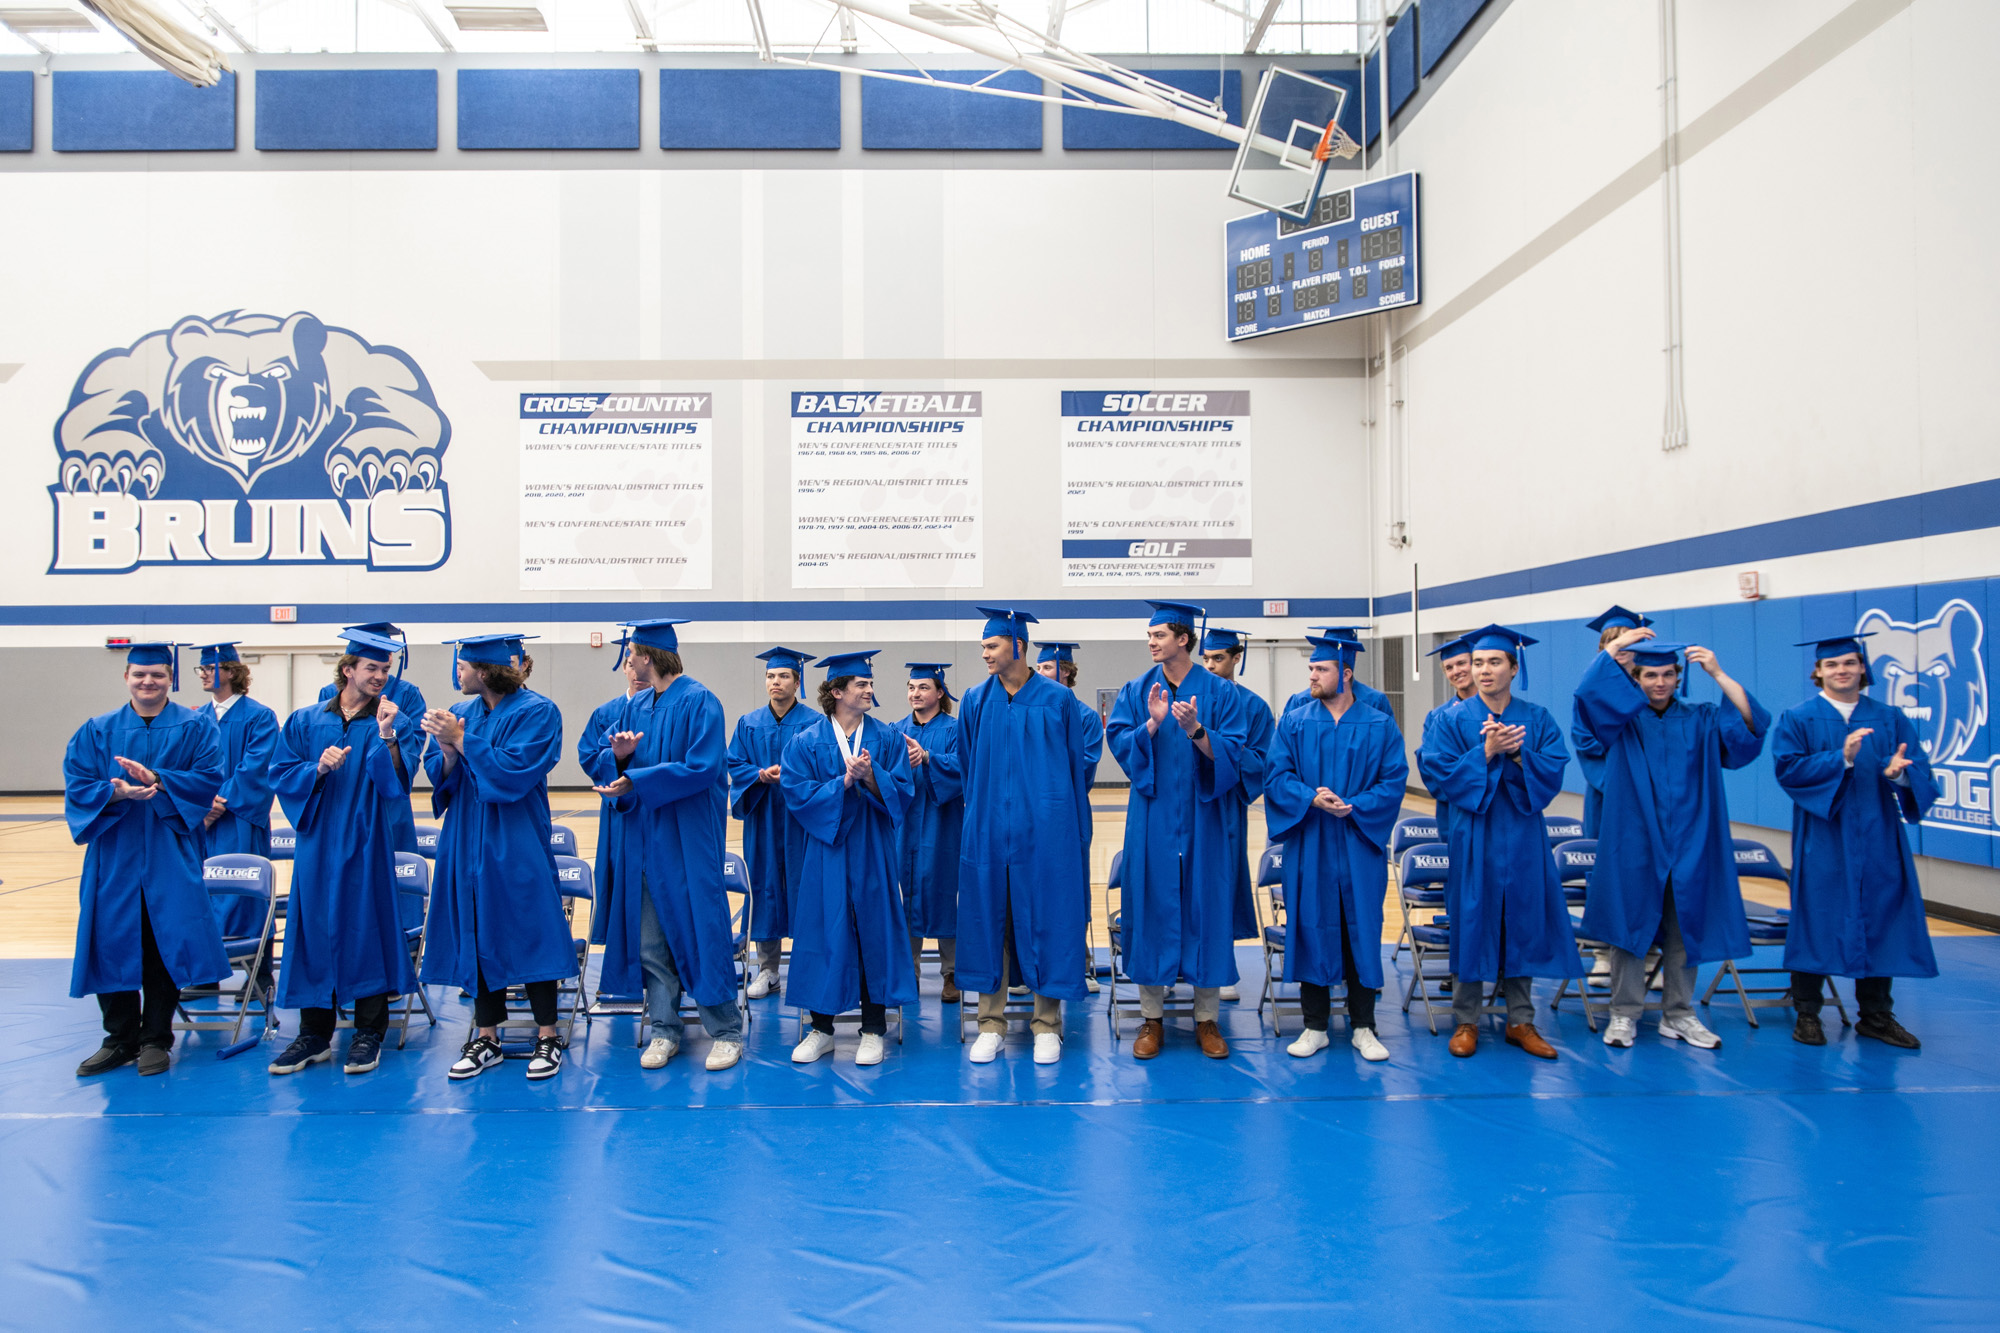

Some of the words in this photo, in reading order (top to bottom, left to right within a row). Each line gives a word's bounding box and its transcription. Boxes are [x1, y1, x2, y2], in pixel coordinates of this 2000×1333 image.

[1360, 210, 1399, 232] GUEST
[1302, 236, 1330, 250] PERIOD
[1240, 244, 1270, 262] HOME
[1378, 256, 1405, 270] FOULS
[1348, 264, 1371, 277] T.O.L.
[1292, 275, 1321, 290] PLAYER
[1322, 271, 1342, 283] FOUL
[1234, 290, 1257, 303] FOULS
[1264, 285, 1284, 296] T.O.L.
[1379, 292, 1406, 306] SCORE
[1303, 308, 1330, 321] MATCH
[1235, 323, 1258, 336] SCORE
[524, 396, 708, 412] CROSS-COUNTRY
[796, 394, 977, 413] BASKETBALL
[1102, 394, 1208, 412] SOCCER
[538, 422, 698, 434] CHAMPIONSHIPS
[806, 421, 965, 433] CHAMPIONSHIPS
[1077, 420, 1234, 432] CHAMPIONSHIPS
[574, 443, 668, 451] CONFERENCE/STATE
[832, 479, 933, 487] REGIONAL/DISTRICT
[53, 489, 446, 570] BRUINS
[558, 520, 653, 528] CONFERENCE/STATE
[1128, 542, 1187, 557] GOLF
[558, 557, 654, 565] REGIONAL/DISTRICT
[275, 608, 290, 619] EXIT
[1270, 602, 1285, 614] EXIT
[1934, 807, 1992, 825] COLLEGE
[1404, 826, 1439, 836] KELLO
[271, 837, 296, 846] KELLO
[1414, 856, 1450, 866] KELLO
[204, 867, 260, 879] KELLOGG
